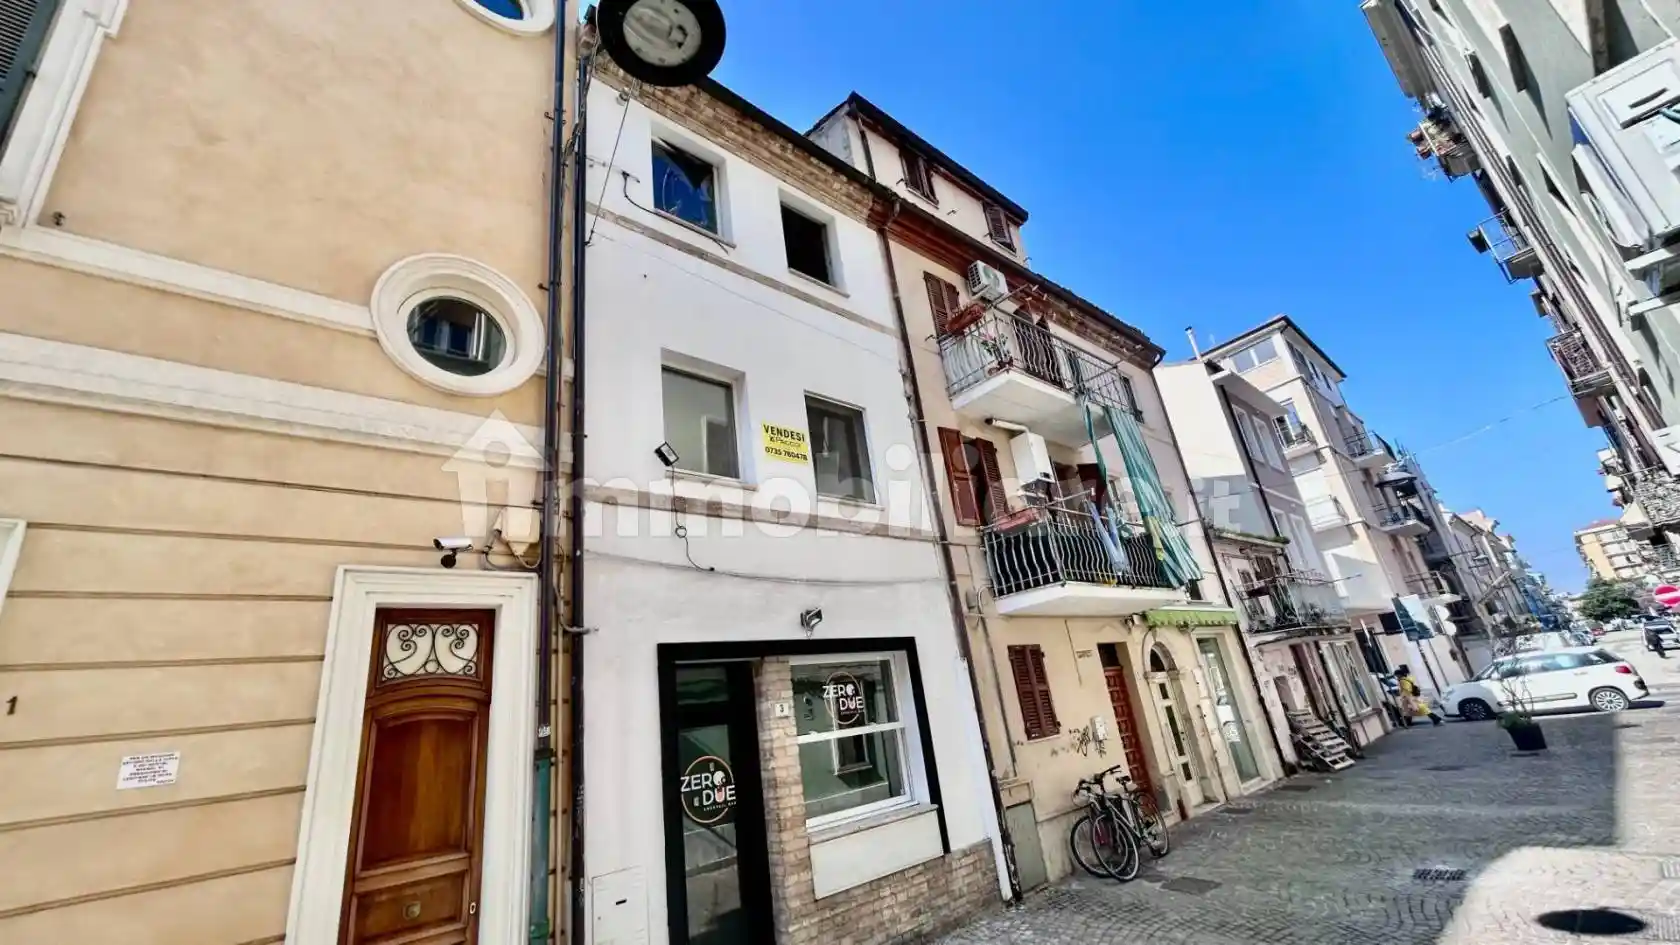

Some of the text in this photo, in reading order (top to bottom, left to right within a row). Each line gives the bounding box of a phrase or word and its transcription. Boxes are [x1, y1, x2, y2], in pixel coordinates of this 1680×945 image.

[763, 424, 805, 442] VENDESI
[765, 446, 782, 456] 0735
[823, 683, 856, 698] ZERO
[6, 695, 18, 715] 1
[839, 696, 865, 711] DUE
[680, 770, 727, 792] ZERO
[702, 784, 737, 806] DUE
